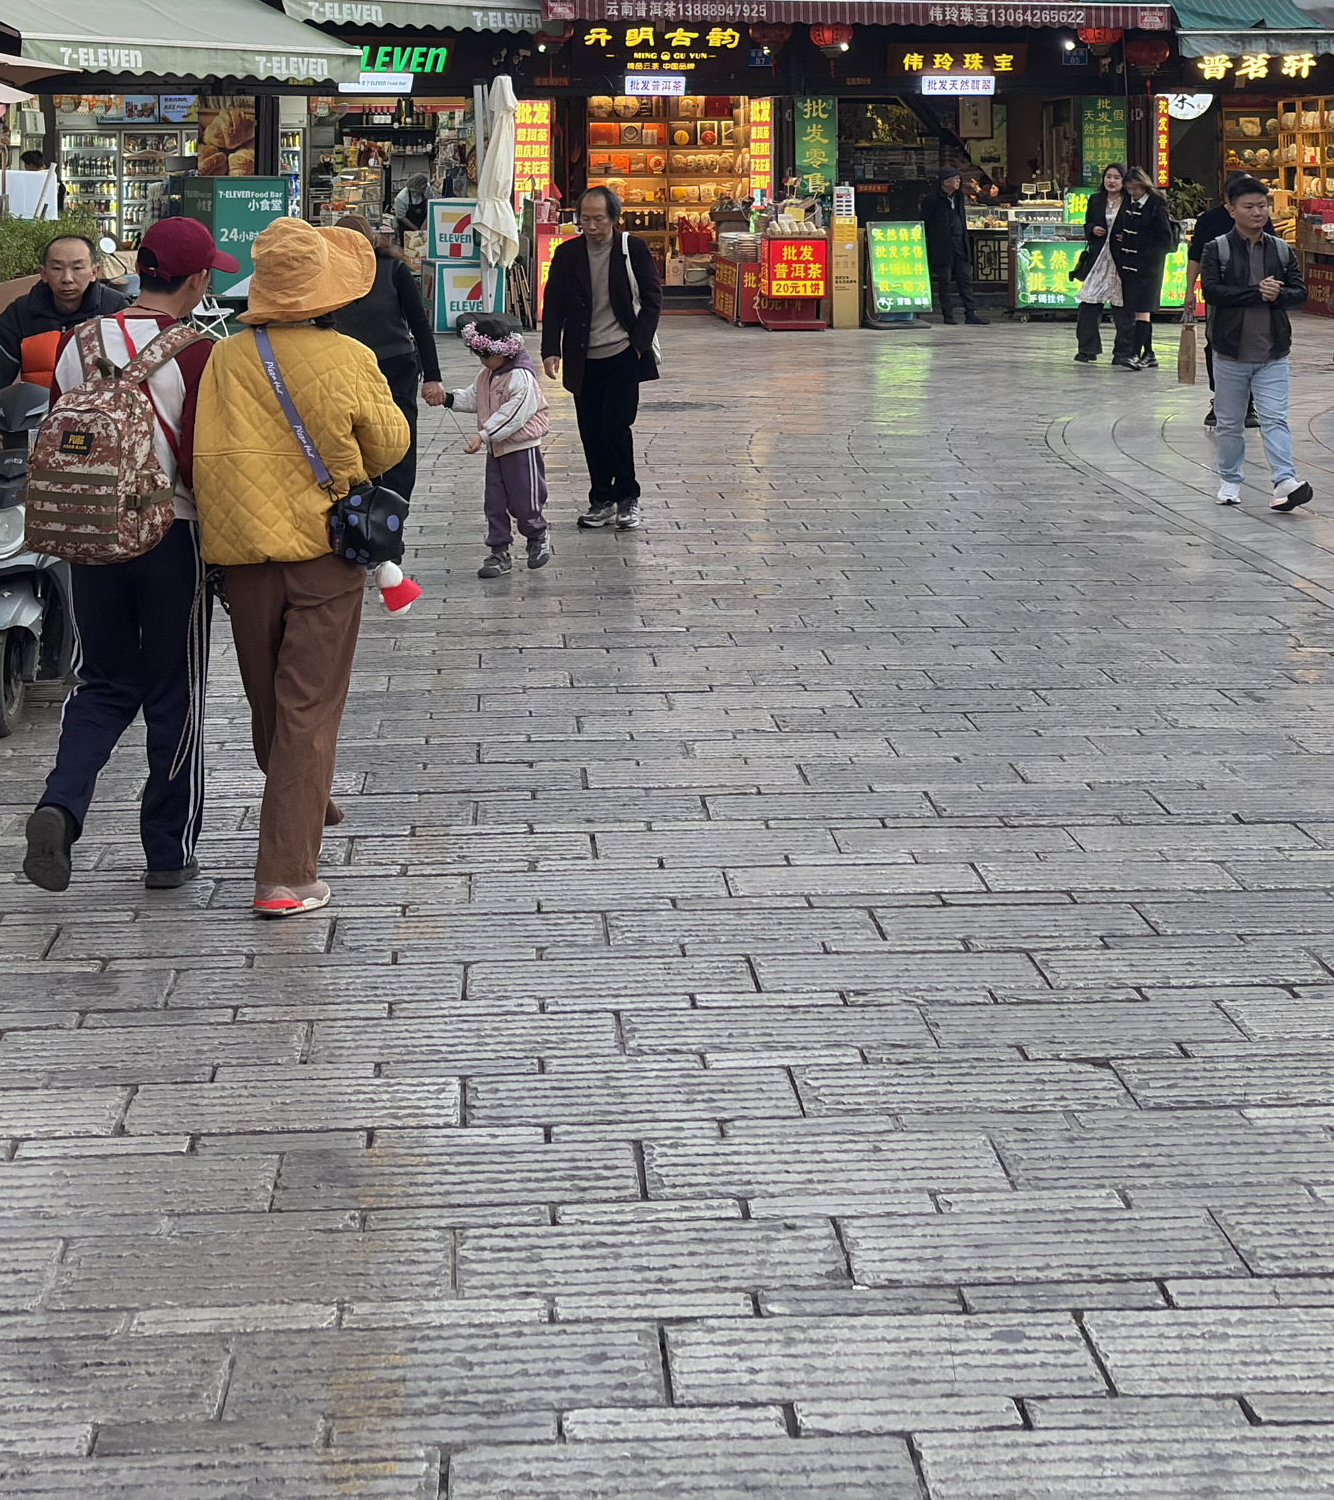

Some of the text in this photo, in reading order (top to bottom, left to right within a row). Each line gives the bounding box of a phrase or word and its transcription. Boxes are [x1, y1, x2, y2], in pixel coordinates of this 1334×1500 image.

[308, 2, 384, 21] 7-ELEVEN
[472, 11, 543, 29] 7-ELEVEN
[583, 27, 740, 48] 开明古韵
[60, 47, 143, 68] 7-ELEVEN
[353, 46, 448, 73] LEVEN
[755, 57, 766, 65] 87
[903, 53, 1014, 72] 伟玲珠宝
[255, 56, 328, 76] 7-ELEVEN
[662, 62, 696, 70] 中国品牌
[630, 80, 683, 92] 批发普洱茶
[927, 79, 992, 92] 批发天然翡翠
[515, 102, 550, 124] 批发
[516, 128, 548, 141] 普洱茶
[802, 98, 830, 194] 批发零售
[218, 190, 251, 198] 7-ELEVEN
[251, 190, 269, 198] Food
[248, 199, 283, 212] 小食堂
[439, 233, 472, 244] ELEVEN
[782, 245, 814, 261] 批发
[875, 245, 923, 259] 批发零售
[773, 263, 822, 279] 普洱茶
[775, 282, 821, 295] 20元1饼
[450, 301, 483, 312] ELEVE
[265, 361, 277, 381] Pizza
[293, 425, 307, 445] Pizza
